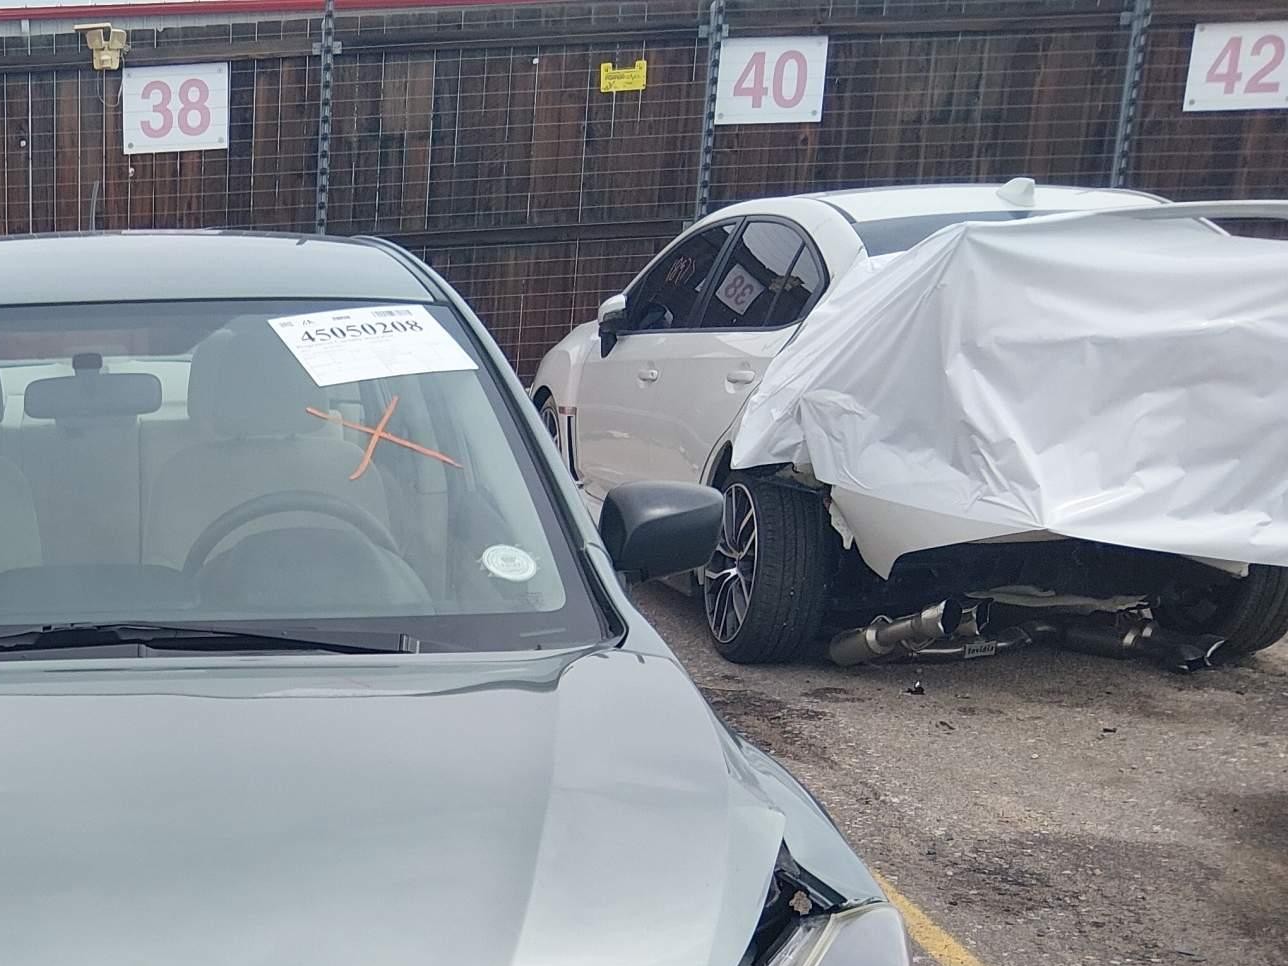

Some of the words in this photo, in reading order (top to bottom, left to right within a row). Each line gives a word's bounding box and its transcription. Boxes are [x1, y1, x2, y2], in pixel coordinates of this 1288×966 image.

[733, 49, 808, 109] 40
[1206, 34, 1286, 95] 42
[140, 78, 211, 139] 38
[300, 319, 424, 344] 45050208
